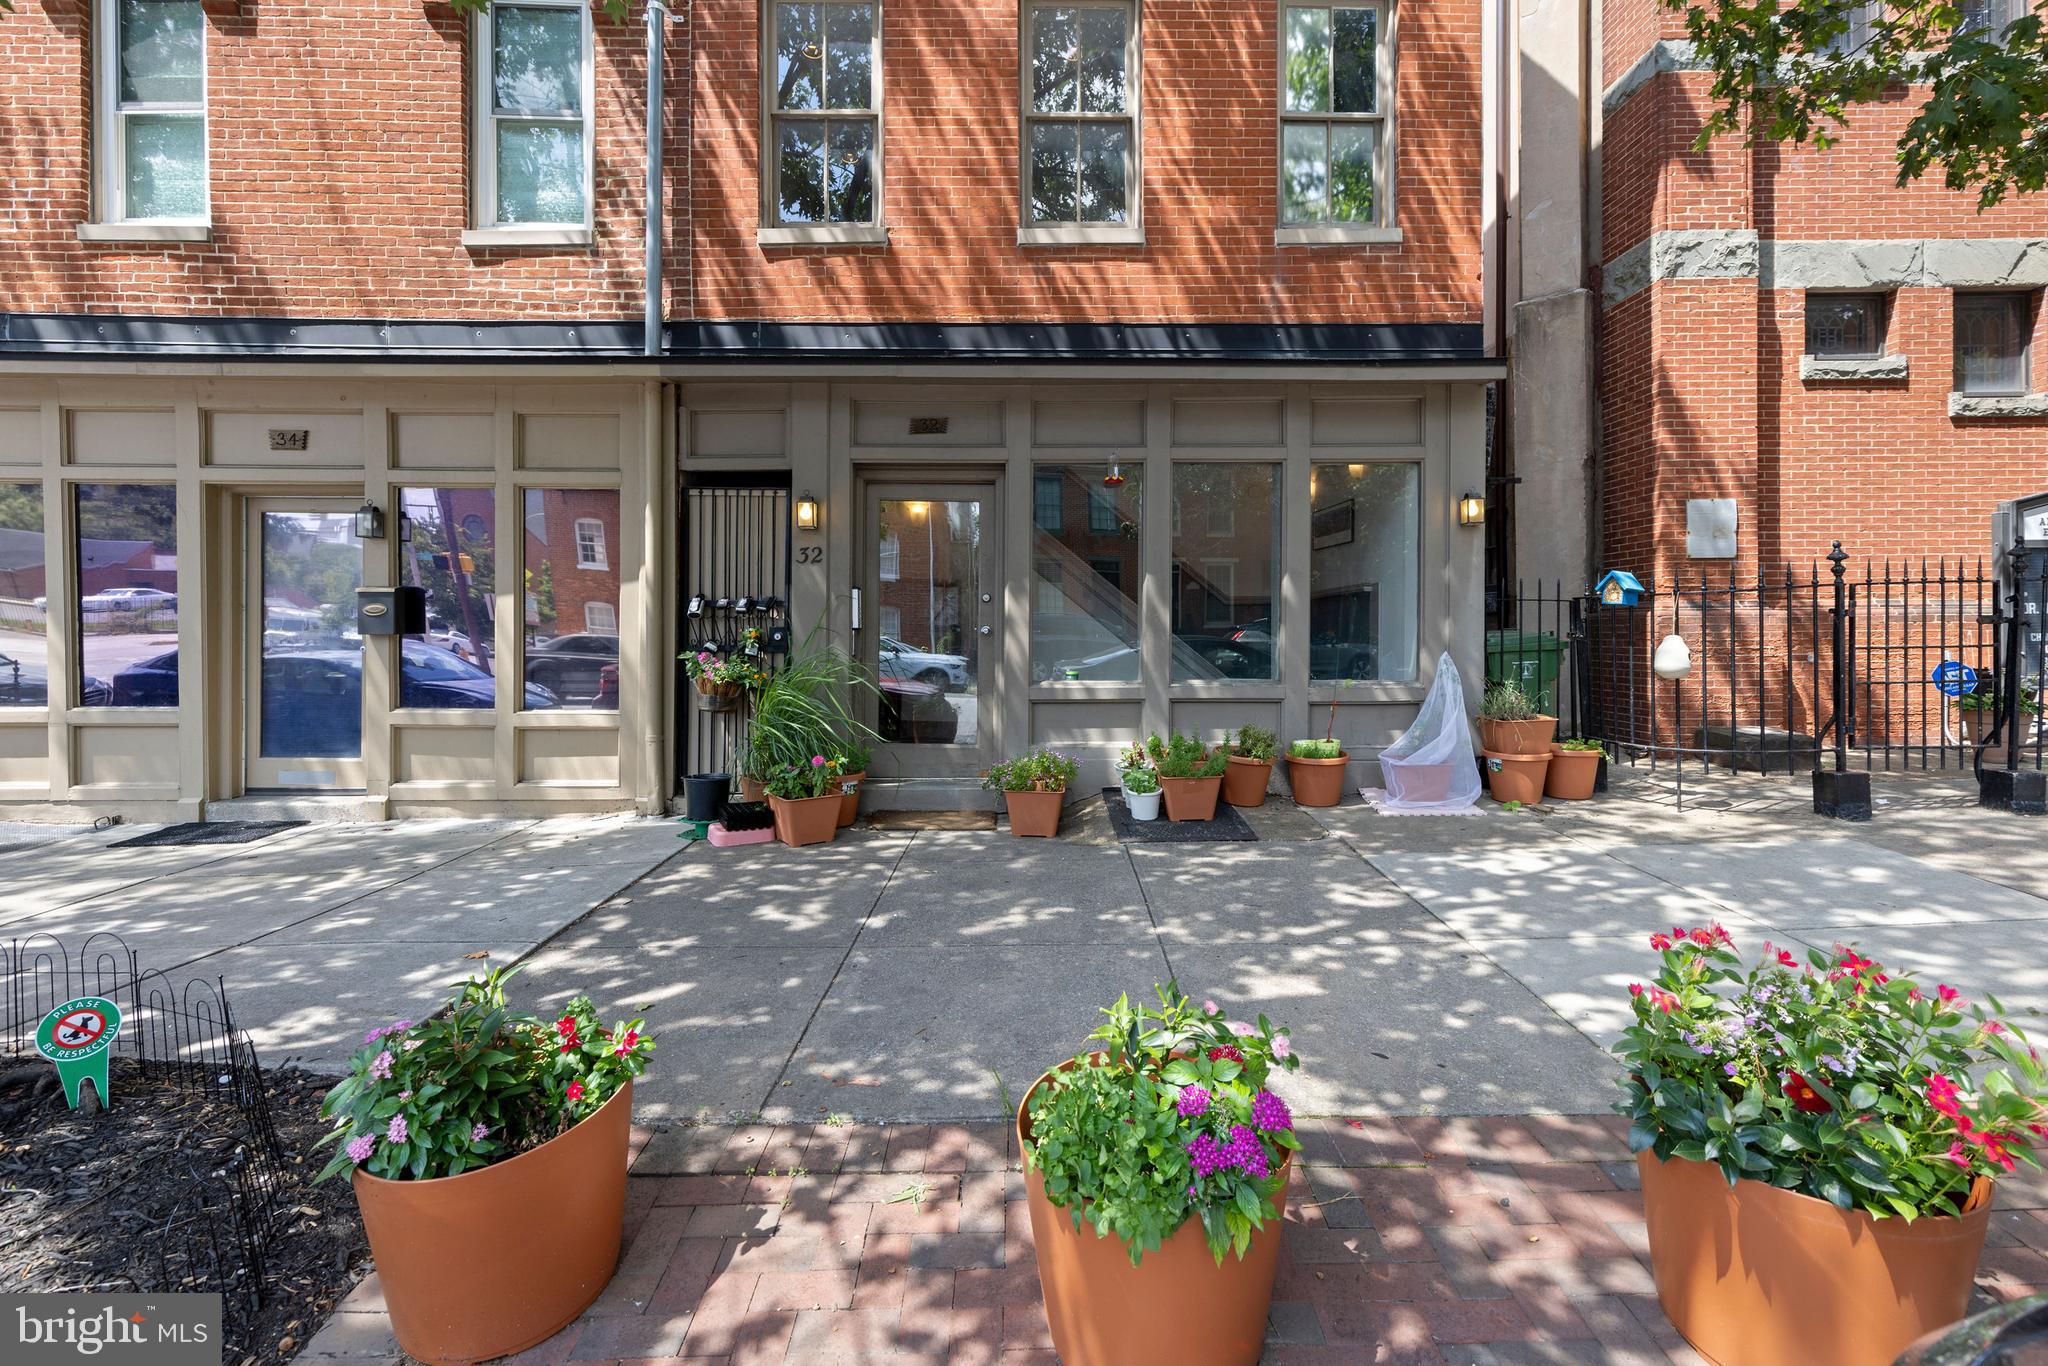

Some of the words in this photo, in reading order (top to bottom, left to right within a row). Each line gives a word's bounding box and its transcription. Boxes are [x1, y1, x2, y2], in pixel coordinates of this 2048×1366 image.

[919, 417, 938, 432] 32
[796, 546, 823, 564] 32
[53, 1000, 101, 1019] PLEASE
[42, 1042, 56, 1054] BE
[56, 1022, 118, 1058] RESPECTFUL
